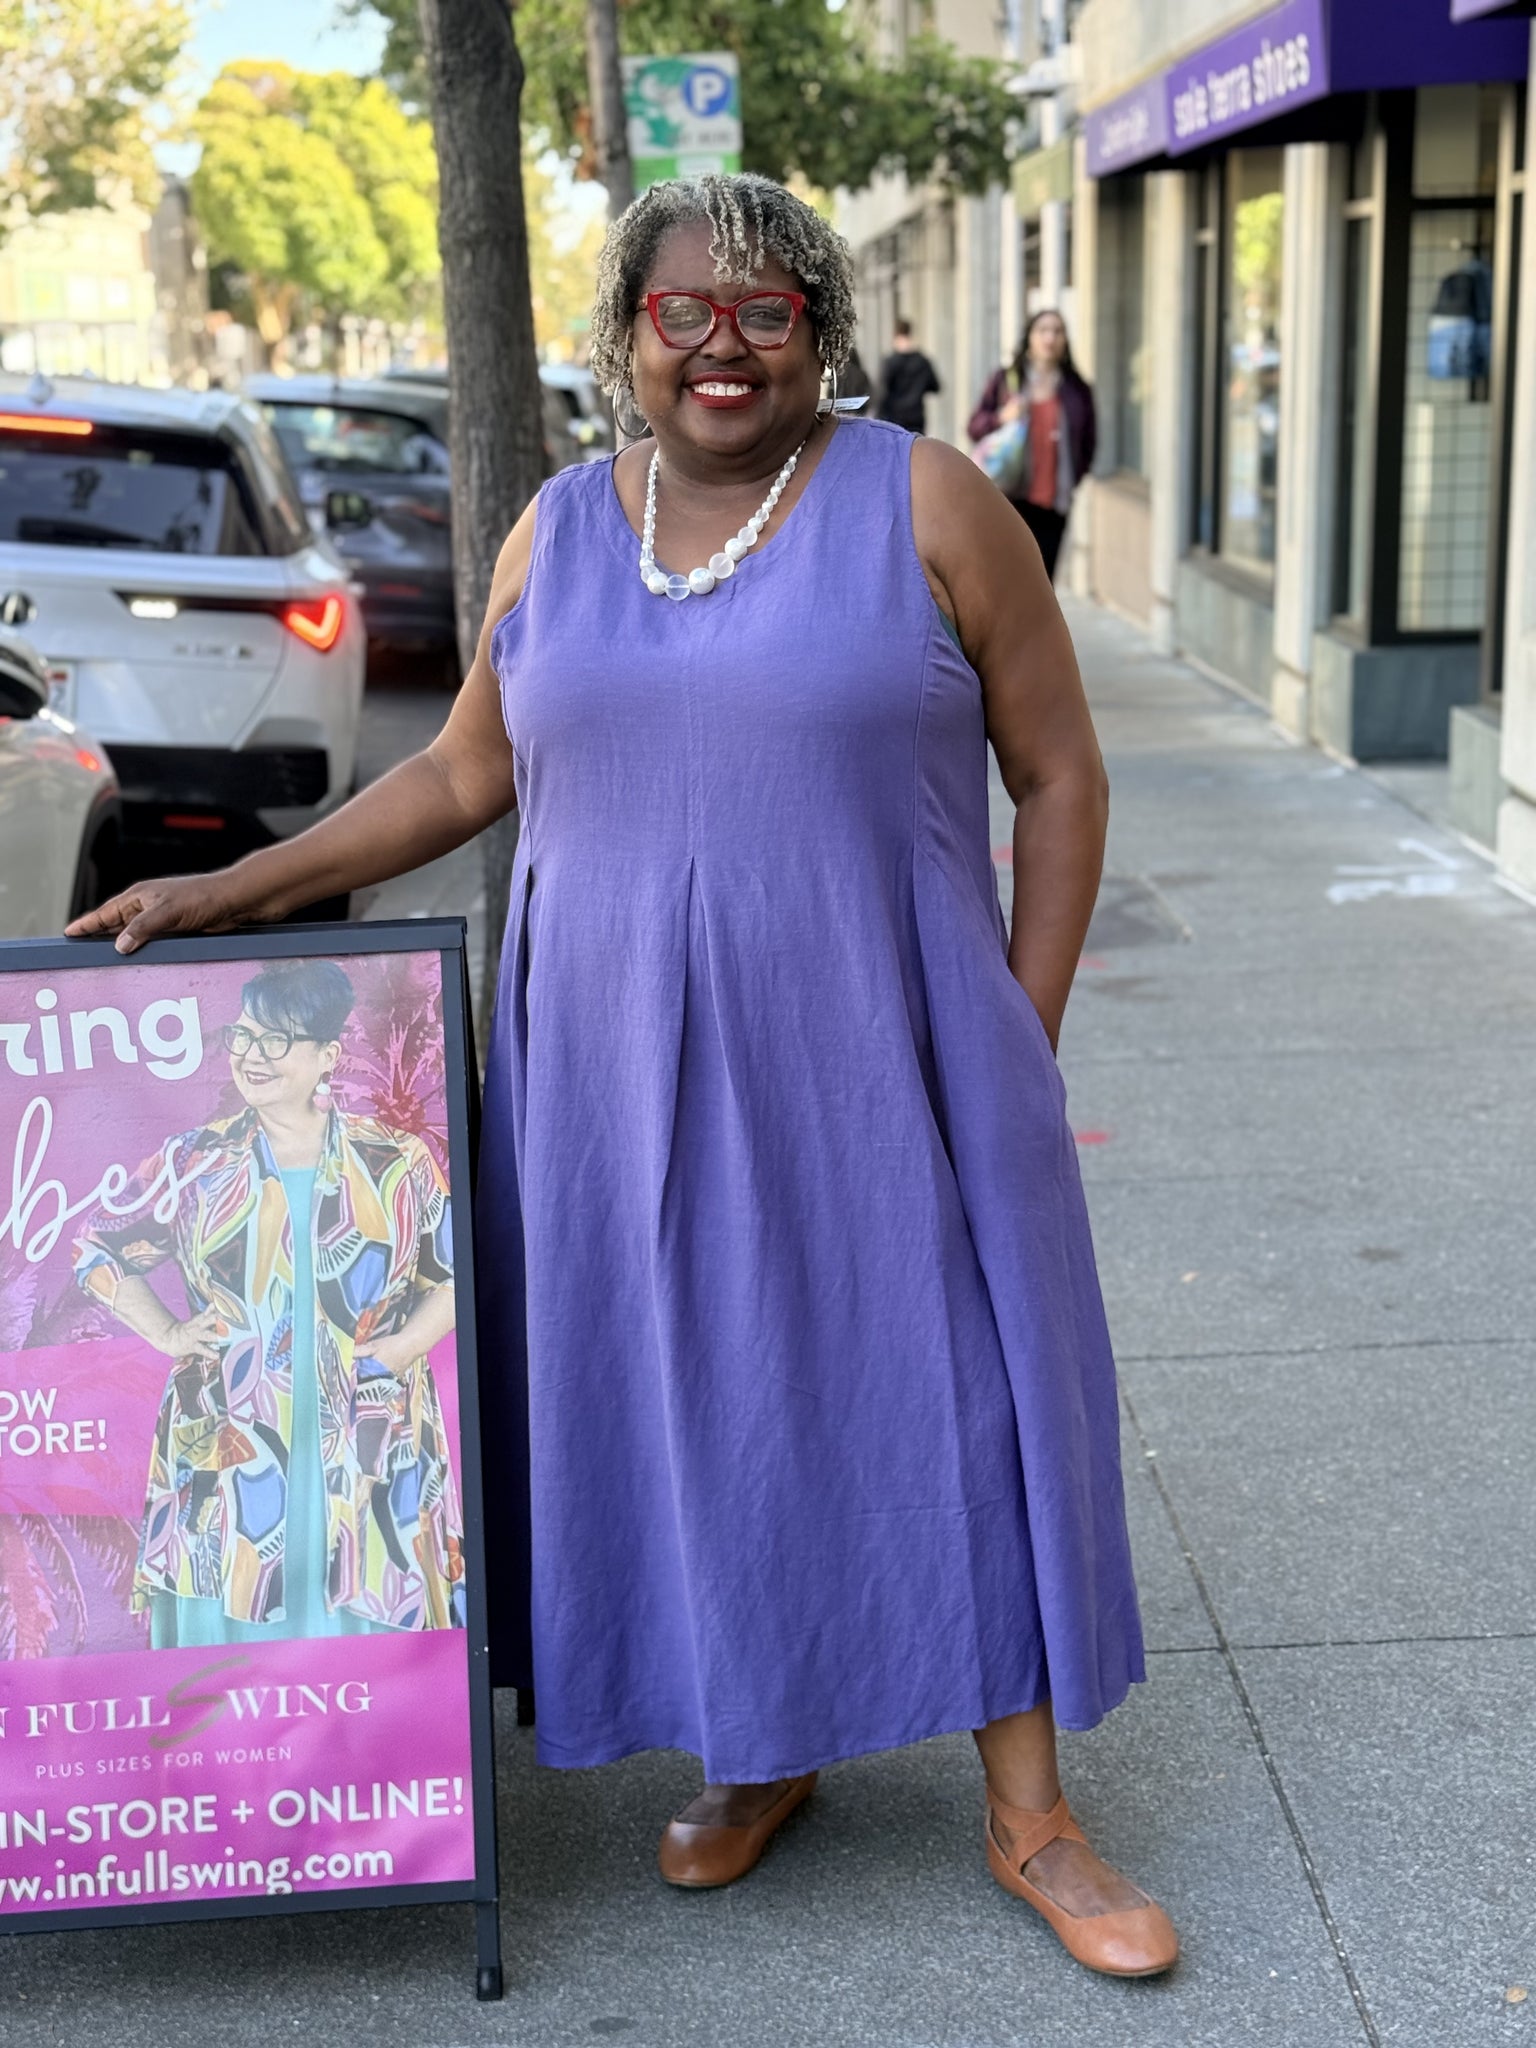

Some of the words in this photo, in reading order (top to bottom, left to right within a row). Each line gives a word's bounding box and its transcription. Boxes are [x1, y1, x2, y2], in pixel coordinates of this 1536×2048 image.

[691, 73, 724, 112] P
[1253, 33, 1310, 105] shoes
[25, 1695, 171, 1738] FULL
[36, 1762, 85, 1779] PLUS
[97, 1755, 152, 1774] SIZES
[163, 1752, 204, 1768] FOR
[216, 1746, 292, 1765] WOMEN
[0, 1795, 218, 1848] IN-STORE
[231, 1800, 254, 1824] +
[268, 1776, 464, 1827] ONLINE!
[0, 1846, 394, 1902] w.infullswing.com
